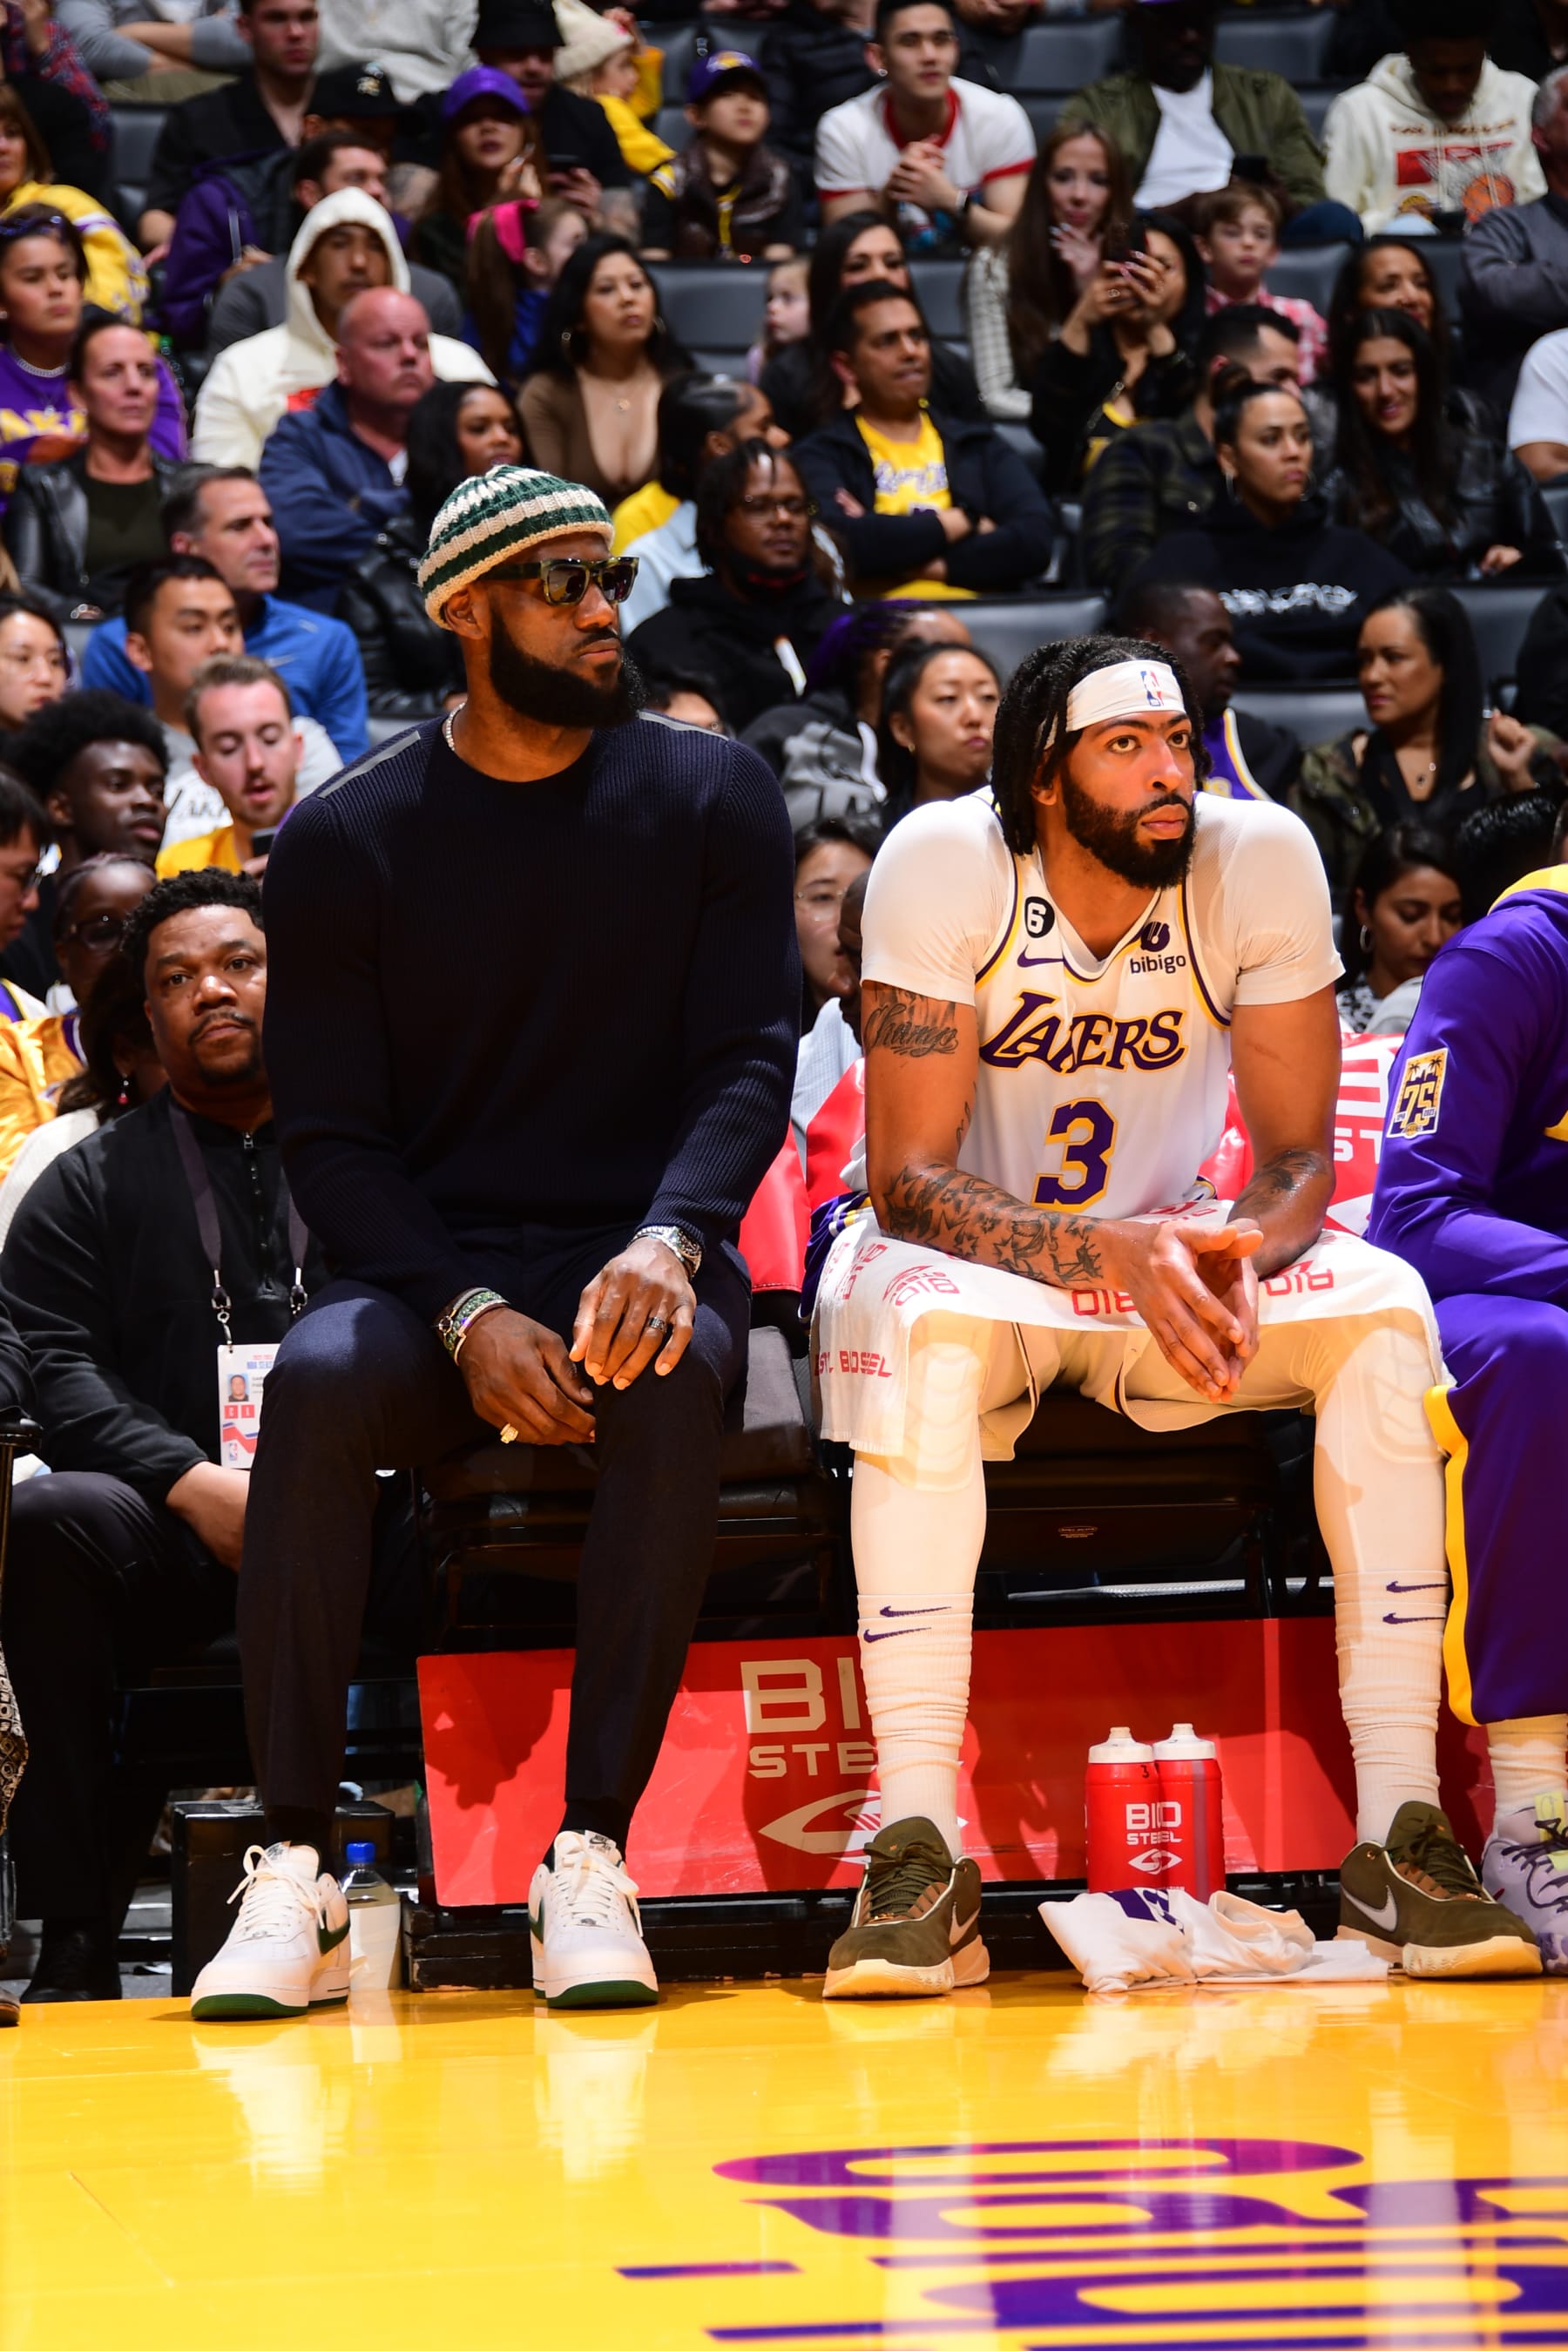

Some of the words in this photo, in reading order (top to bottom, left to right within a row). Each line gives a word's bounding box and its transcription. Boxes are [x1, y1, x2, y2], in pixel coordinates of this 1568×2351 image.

[1026, 901, 1047, 936] 6
[1129, 954, 1187, 974] bibigo
[1400, 1081, 1436, 1129] 75
[1031, 1097, 1119, 1213] 3
[740, 1657, 862, 1734] BI
[748, 1741, 878, 1779] STE
[1140, 1765, 1150, 1779] 3
[1125, 1801, 1182, 1830] BIO
